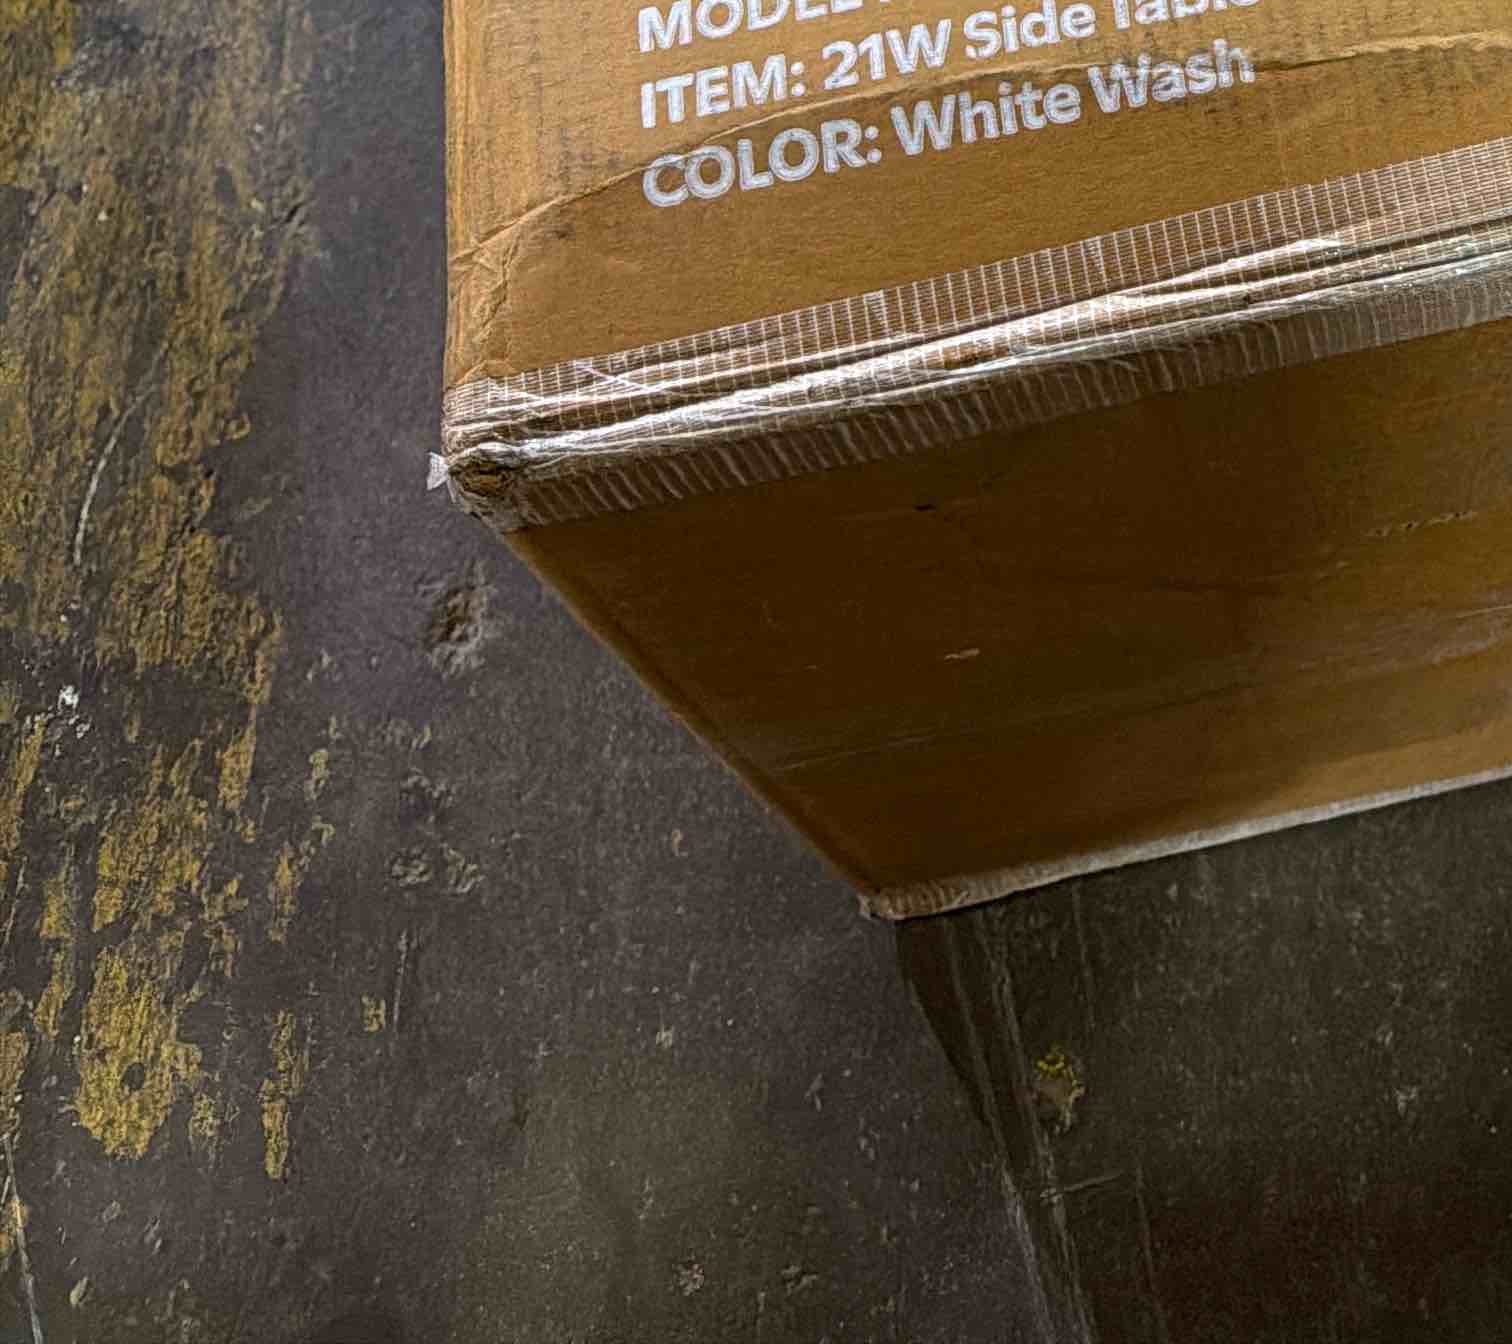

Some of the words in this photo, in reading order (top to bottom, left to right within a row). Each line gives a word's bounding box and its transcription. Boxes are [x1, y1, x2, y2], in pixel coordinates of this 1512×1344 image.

[639, 55, 807, 130] ITEM:
[820, 18, 953, 93] 21W
[641, 118, 883, 209] COLOR:
[889, 77, 1084, 157] White
[1086, 37, 1257, 116] Wash
